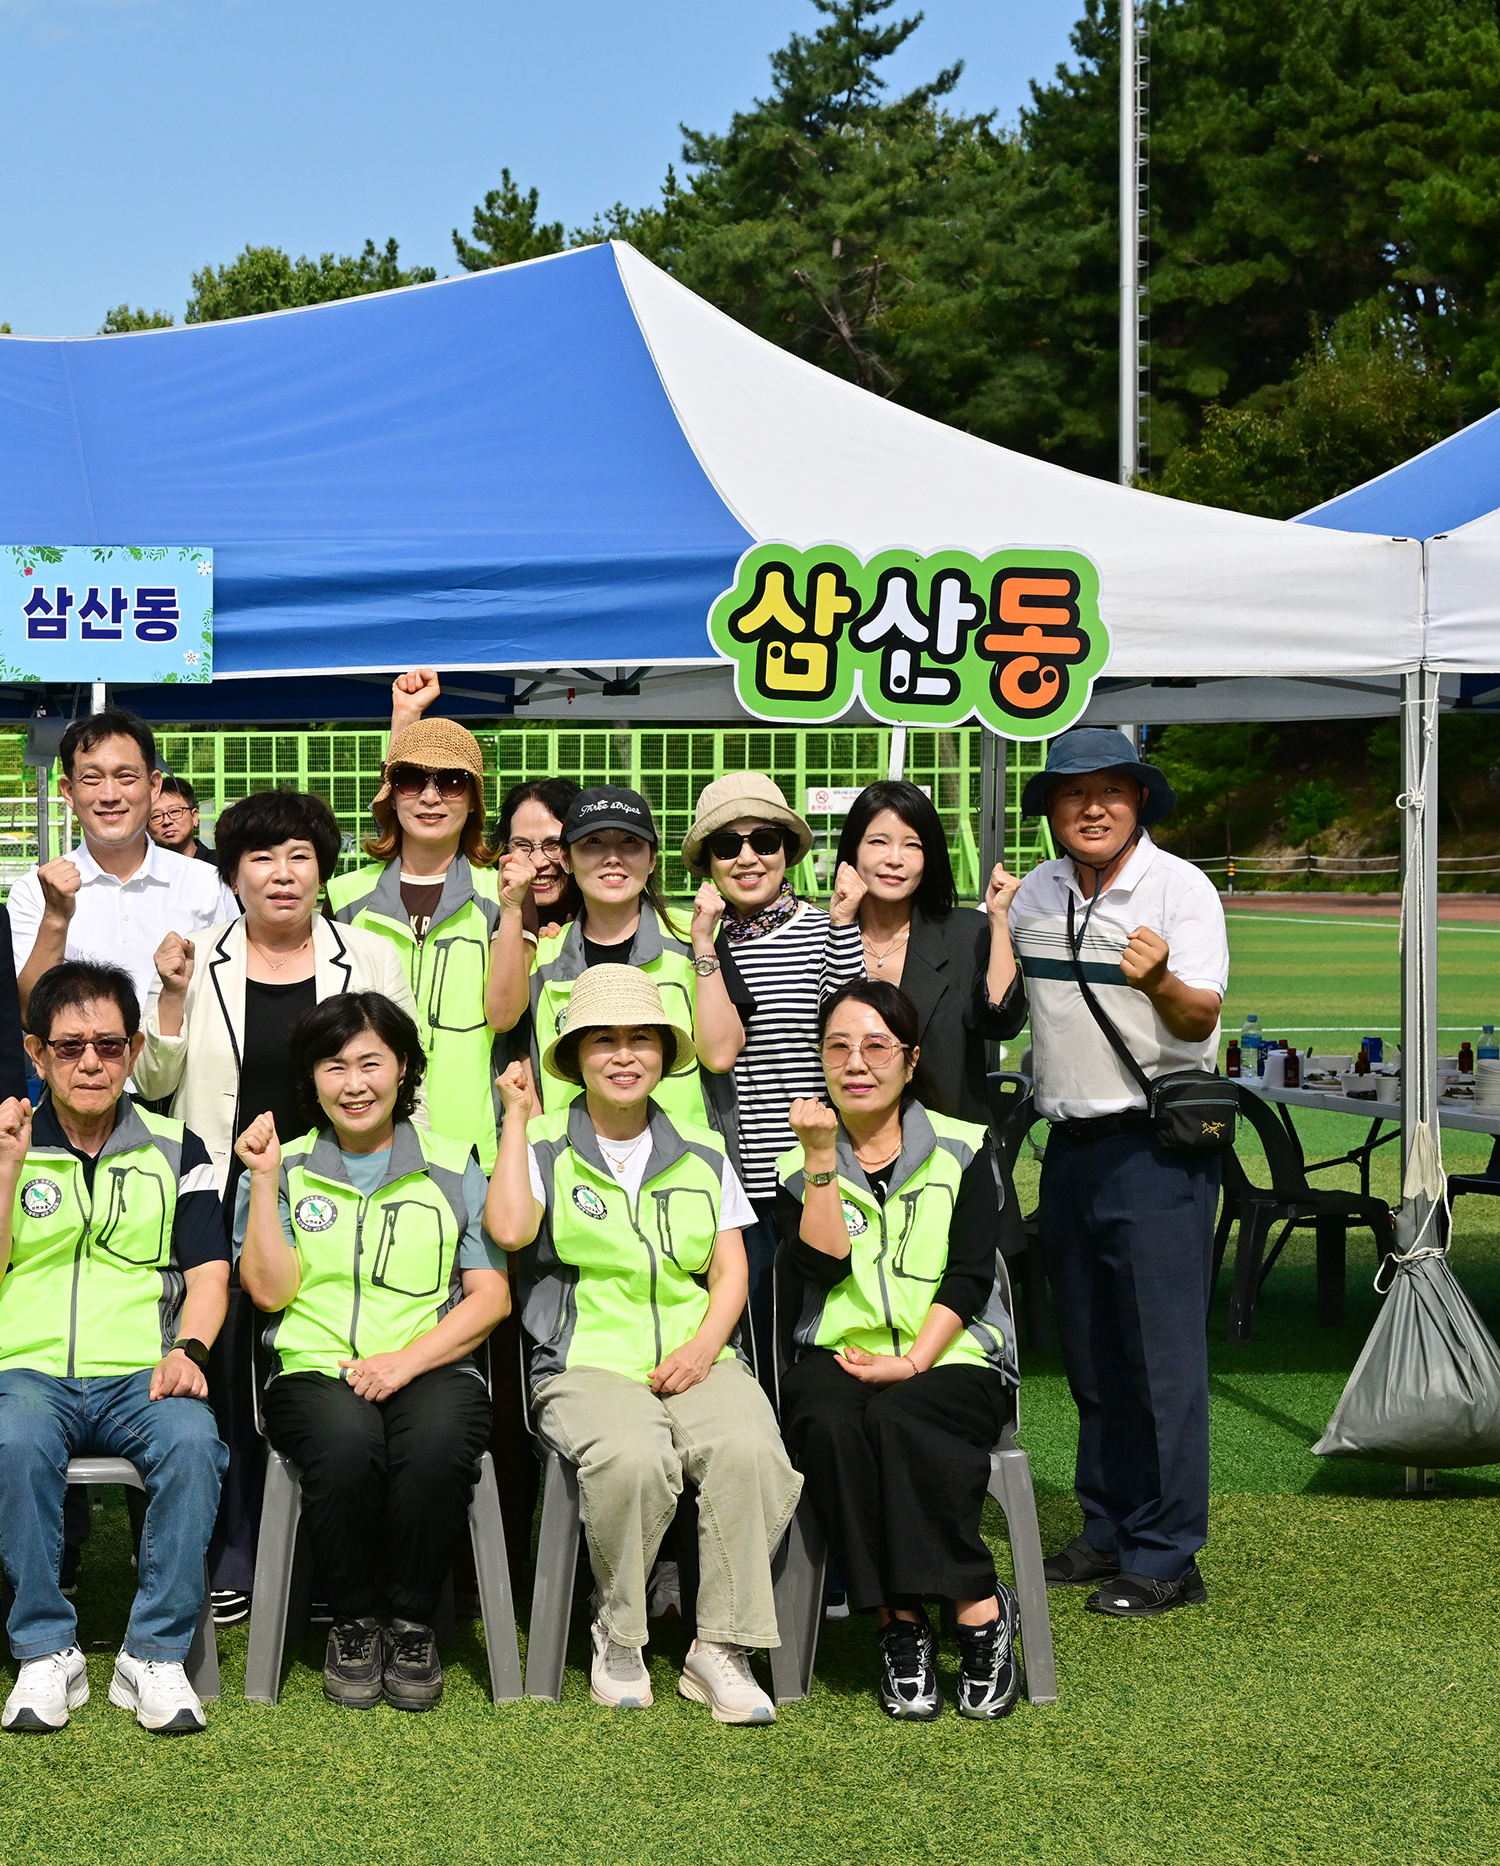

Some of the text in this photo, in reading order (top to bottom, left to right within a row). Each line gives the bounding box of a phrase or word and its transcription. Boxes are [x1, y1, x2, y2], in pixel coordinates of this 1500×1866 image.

[22, 585, 181, 643] 삼산동
[731, 564, 1087, 715] 삼산동
[579, 799, 642, 817] Three stripes
